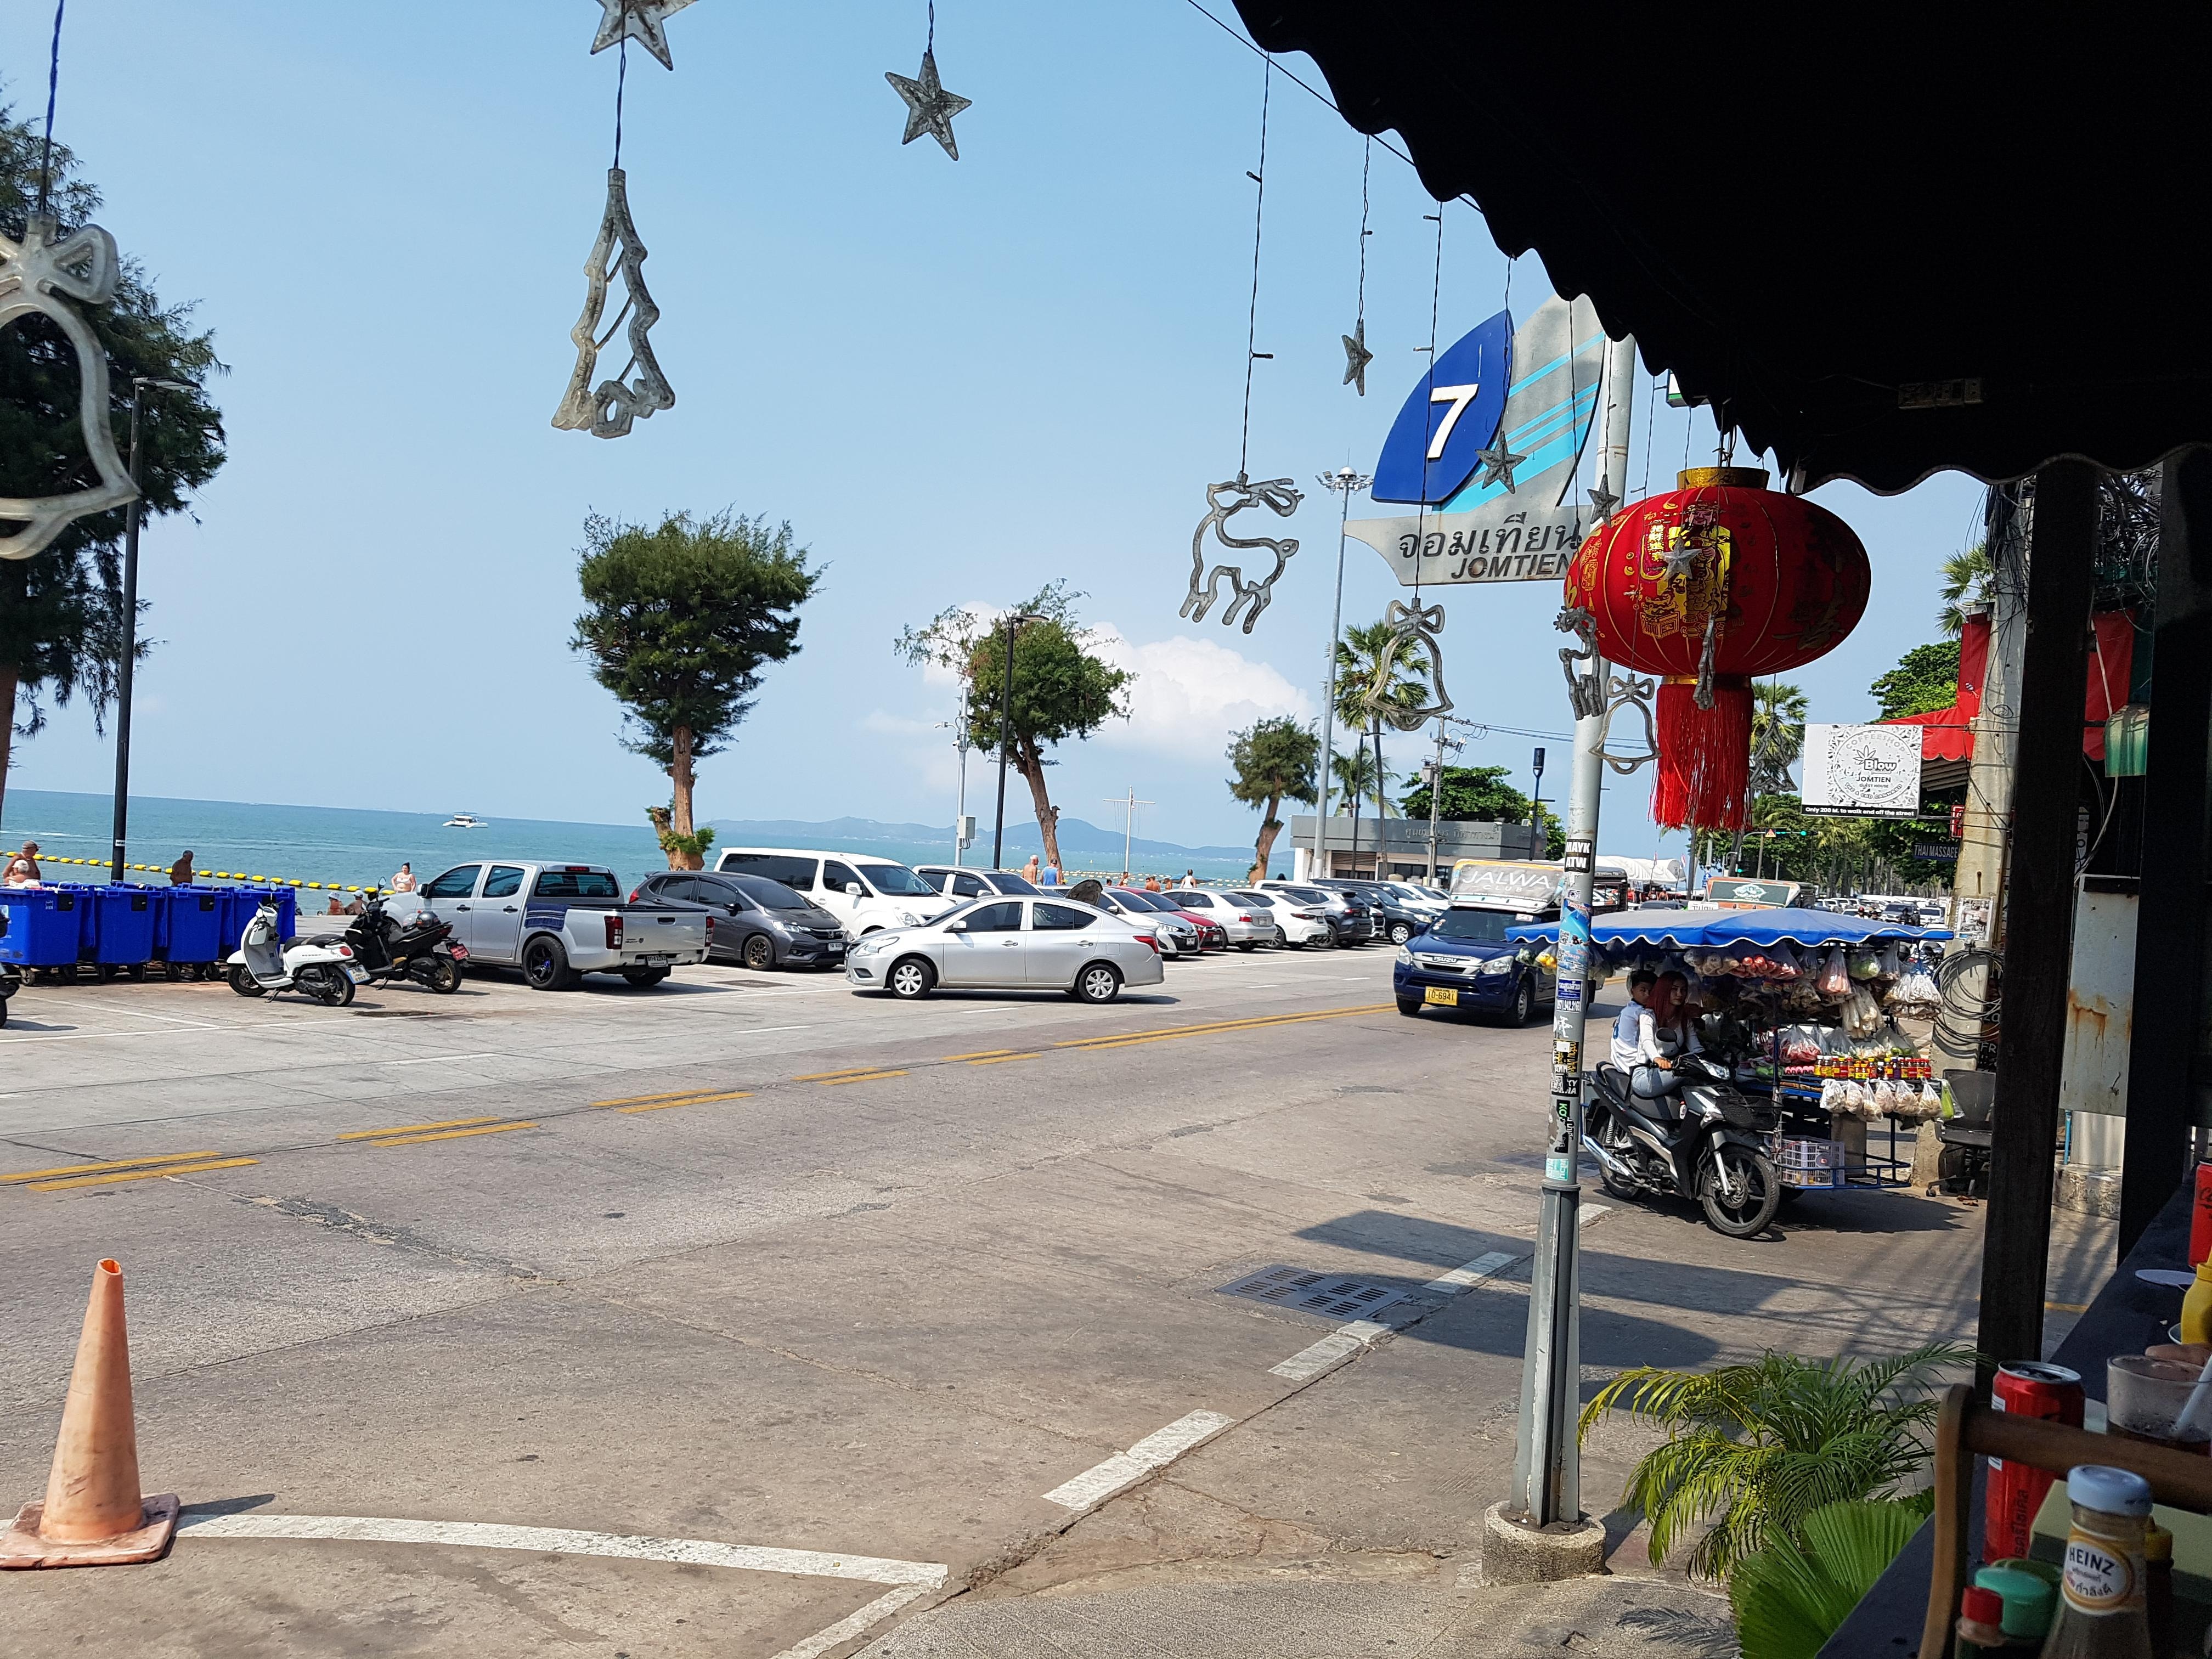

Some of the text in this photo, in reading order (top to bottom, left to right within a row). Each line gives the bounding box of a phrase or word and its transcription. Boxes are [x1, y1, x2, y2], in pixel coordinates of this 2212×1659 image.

[1427, 383, 1479, 459] 7
[1398, 511, 1583, 559] จอมเทียน
[1451, 551, 1571, 579] JOMTIEN
[1846, 733, 1905, 752] COFFEESHOP
[1864, 758, 1897, 771] Blow
[1914, 845, 1959, 858] THAI MASSAGE
[1565, 856, 1587, 868] ATW
[1462, 871, 1550, 889] JALWA
[1483, 884, 1523, 893] CLUB
[2069, 1548, 2115, 1576] HEINZ
